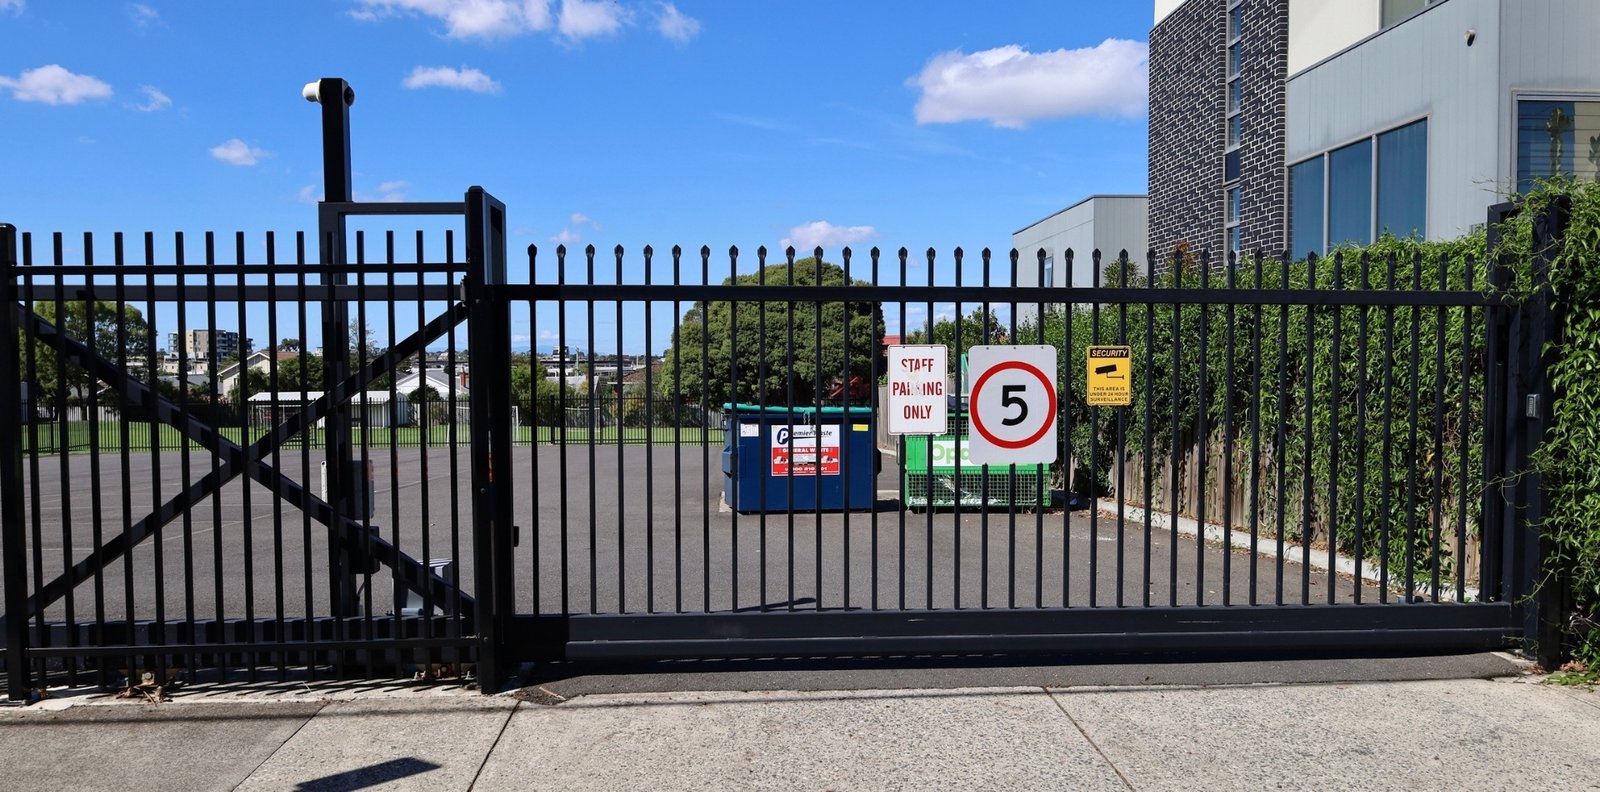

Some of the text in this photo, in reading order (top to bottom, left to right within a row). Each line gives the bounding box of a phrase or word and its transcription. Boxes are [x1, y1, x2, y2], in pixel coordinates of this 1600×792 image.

[901, 358, 934, 373] STAFF
[892, 381, 943, 396] PAING
[903, 405, 932, 419] ONLY
[1001, 384, 1029, 426] 5
[778, 430, 812, 443] Pemier
